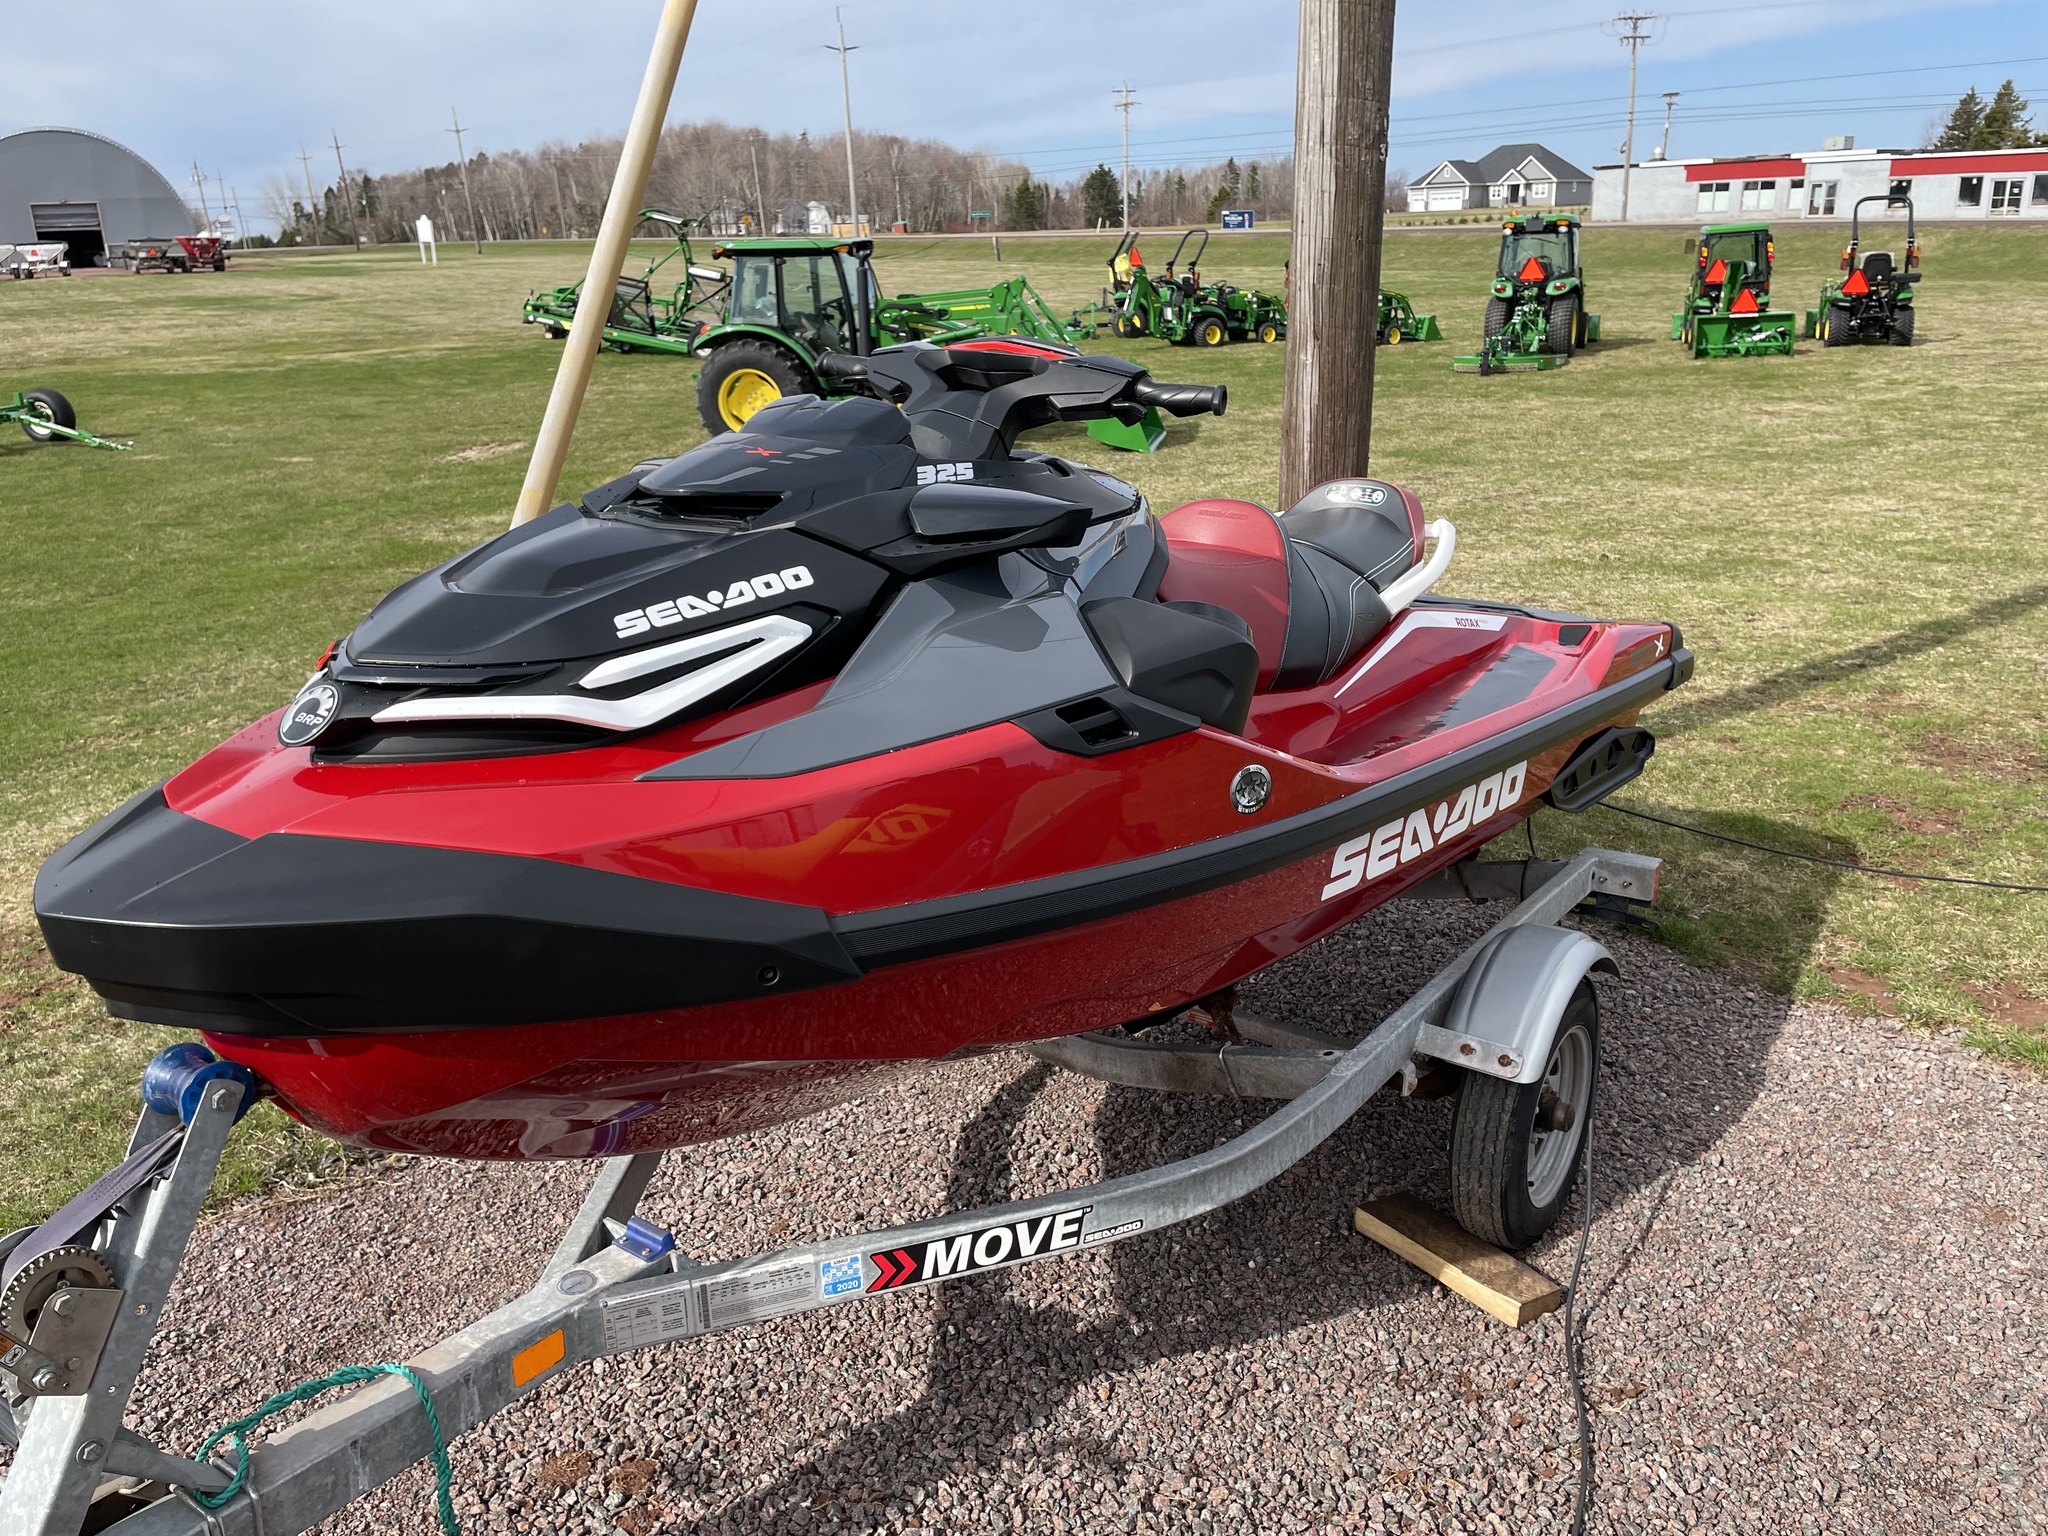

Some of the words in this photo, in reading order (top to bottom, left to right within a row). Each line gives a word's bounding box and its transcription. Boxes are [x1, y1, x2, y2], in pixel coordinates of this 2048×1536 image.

[916, 462, 975, 486] 325
[1455, 617, 1481, 628] ROTAX
[294, 712, 324, 726] BRP
[921, 1208, 1084, 1280] MOVE
[836, 1279, 859, 1292] 2020
